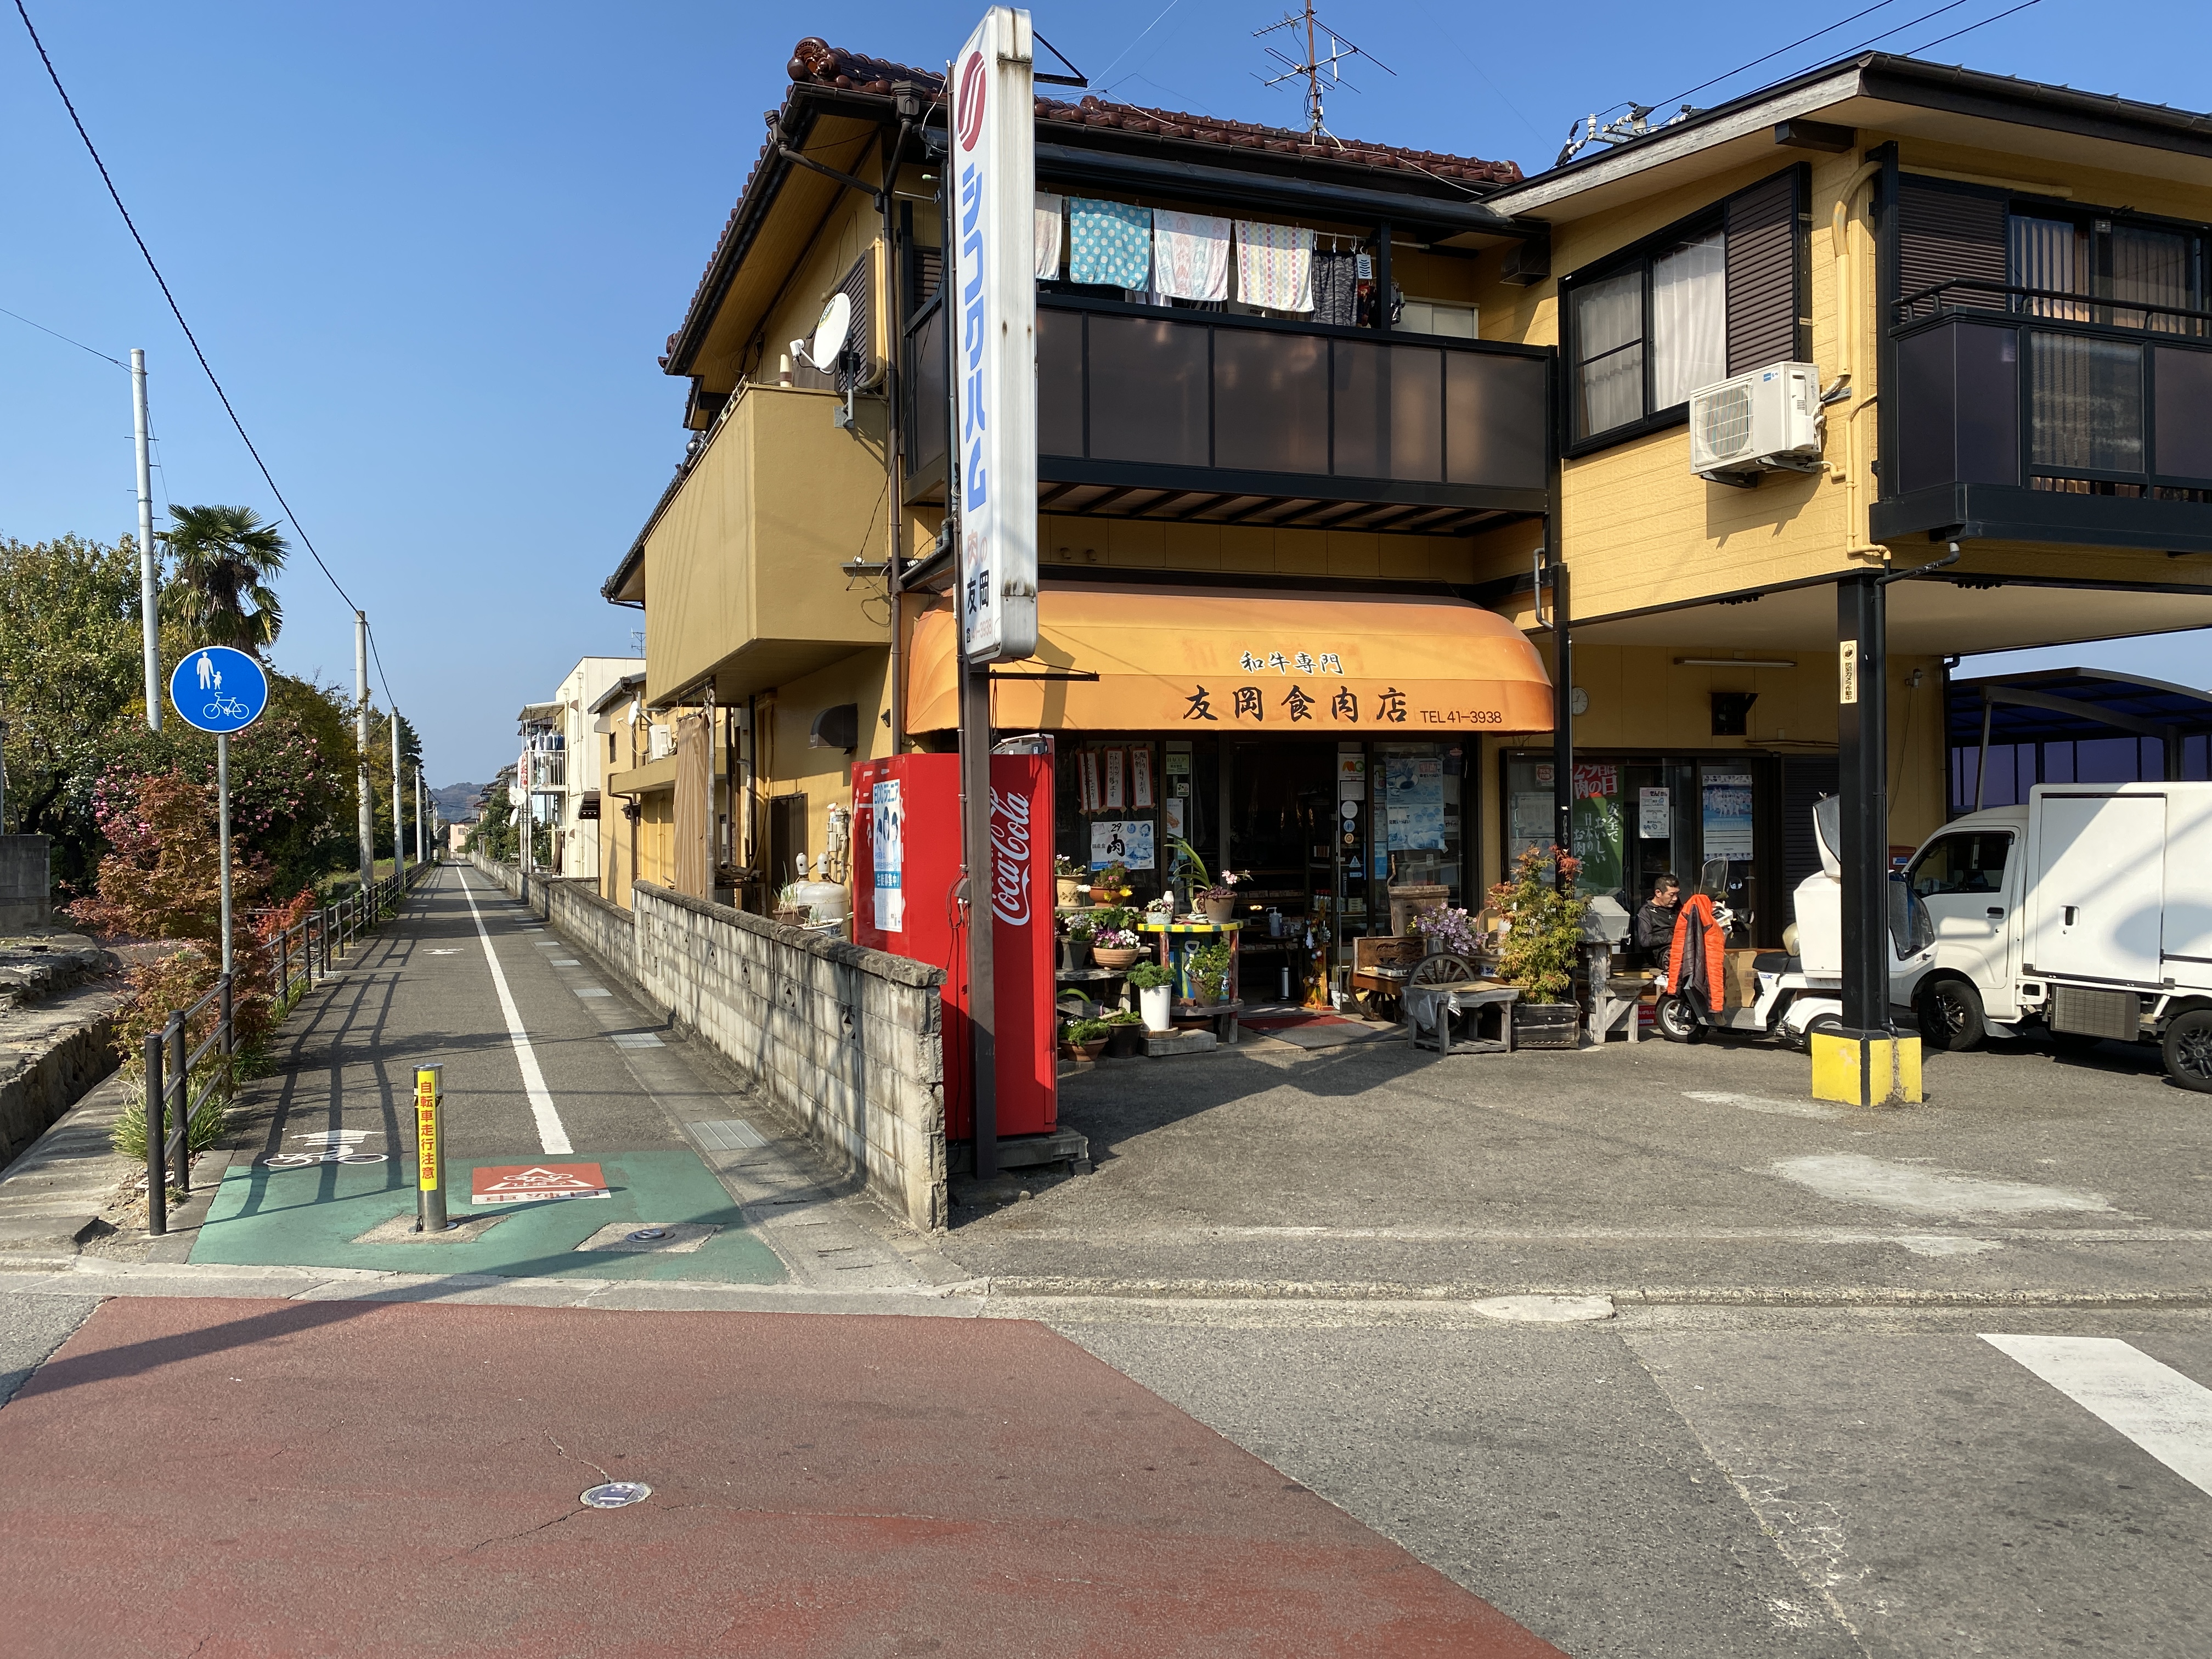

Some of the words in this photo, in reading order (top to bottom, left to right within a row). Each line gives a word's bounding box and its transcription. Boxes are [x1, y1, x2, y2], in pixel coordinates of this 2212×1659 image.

[967, 528, 988, 571] 肉の
[967, 569, 990, 616] 友岡
[1239, 651, 1345, 675] 和牛専門
[1183, 684, 1408, 723] 友岡食肉店
[1574, 775, 1618, 800] 肉の日
[1110, 822, 1122, 832] 29
[1584, 812, 1594, 852] 日本の
[1594, 816, 1607, 864] おいしい
[1607, 802, 1620, 843] 安全で
[990, 786, 1030, 926] Coca-Cola
[1107, 833, 1125, 857] 肉
[877, 873, 900, 887] 生徒募集中!
[420, 1081, 436, 1180] 自転車走行注意
